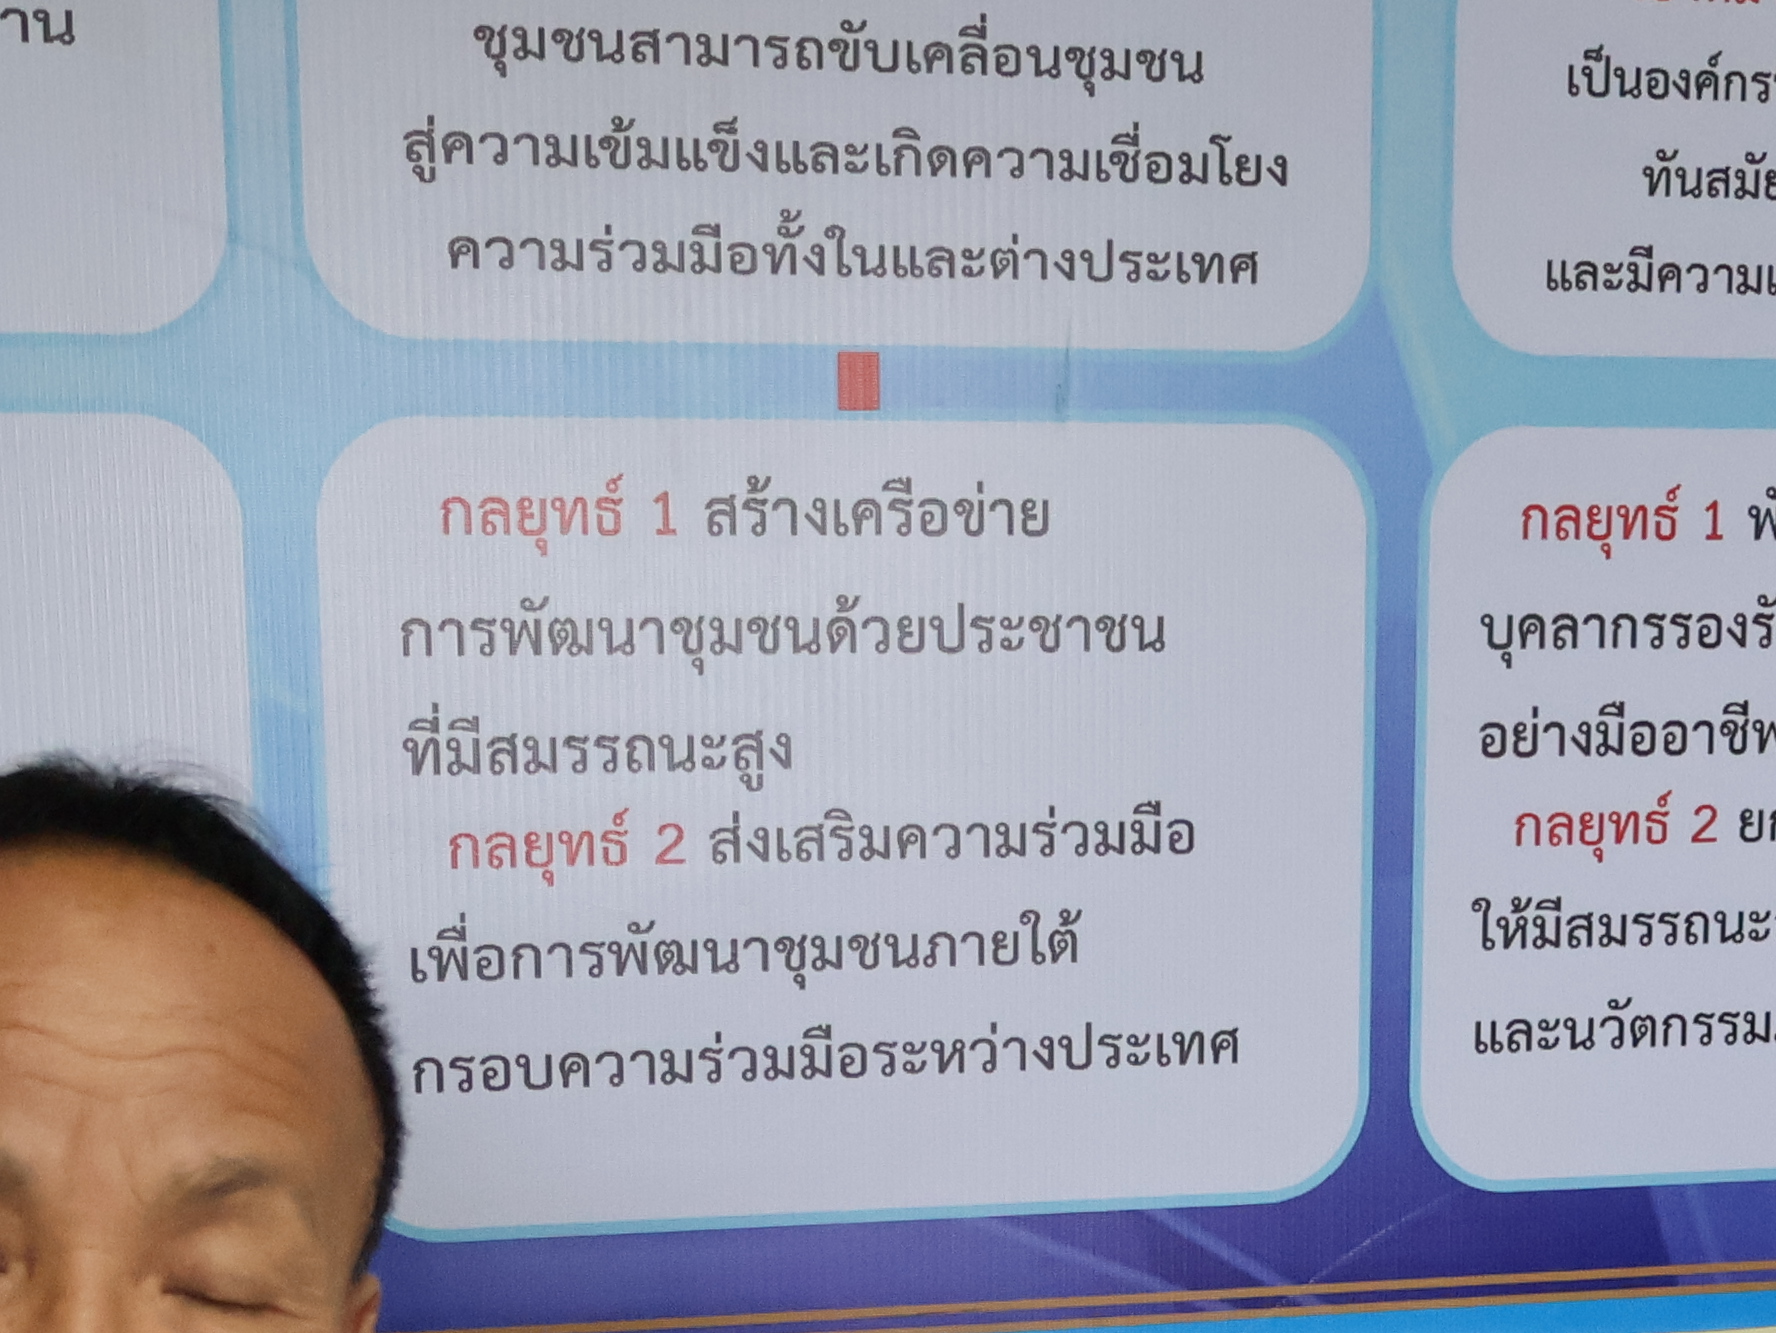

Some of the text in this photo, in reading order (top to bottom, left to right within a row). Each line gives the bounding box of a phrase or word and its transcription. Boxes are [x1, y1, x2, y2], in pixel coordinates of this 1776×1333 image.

[473, 13, 1204, 97] ชุมชนสามารถขับเคลื่อนชุมชน
[403, 115, 1287, 186] สู่ความเข้มแข็งและเกิดความเชื่อมโยง
[448, 209, 1258, 285] ความร่วมมือทั้งในและต่างประเทศ
[440, 473, 1049, 557] กลยุทธ์ 1 สร้างเครือข่าย
[1522, 484, 1681, 560] กลยุทธ์
[1705, 500, 1723, 540] 1
[401, 595, 1165, 676] การพัฒนาชุมชนด้วยประชาชน
[403, 702, 791, 792] ที่มีสมรรถนะสูง
[450, 800, 1194, 887] กลยุทธ์ 2 ส่งเสริมความร่วมมือ
[1516, 790, 1672, 863] กลยุทธ์
[1691, 805, 1717, 843] 2
[411, 908, 1082, 990] เพื่อการพัฒนาชุมชนภายใต้
[413, 1022, 1239, 1094] กรอบความร่วมมือระหว่างประเทศ
